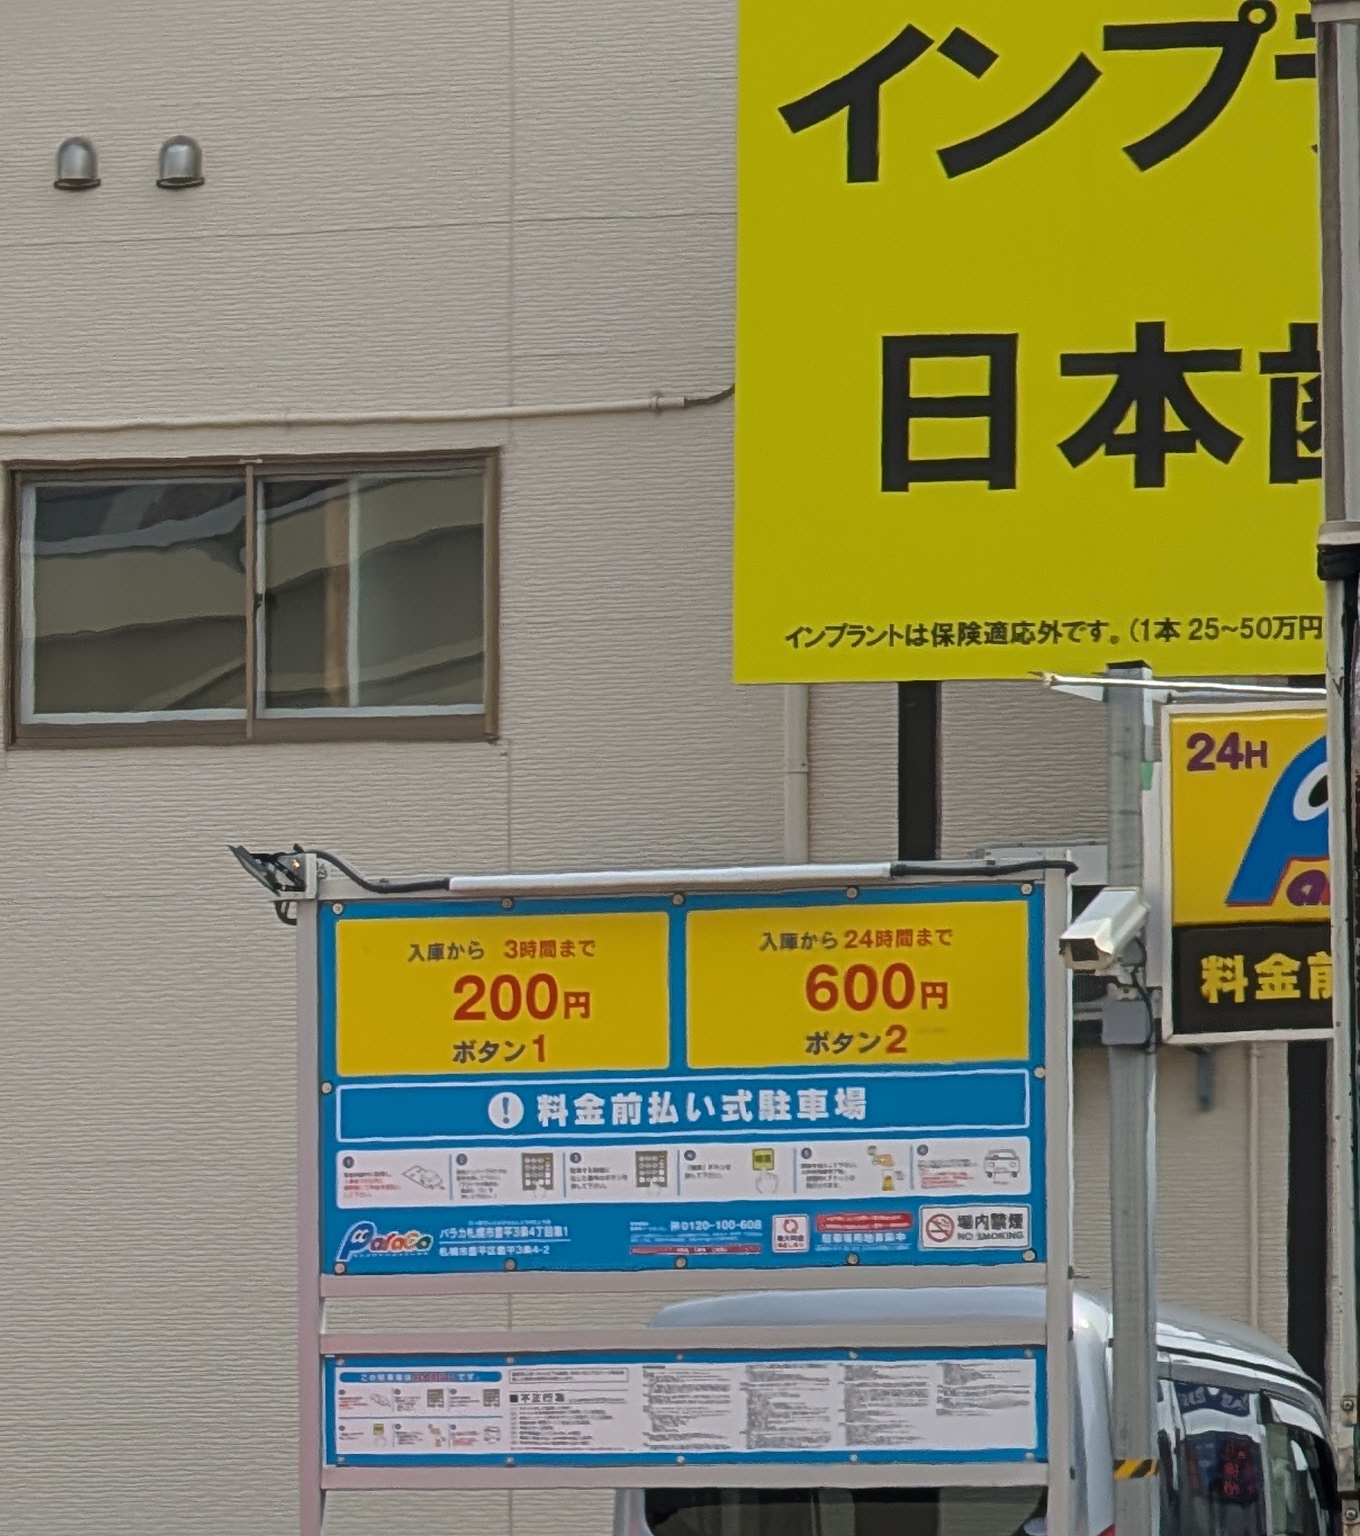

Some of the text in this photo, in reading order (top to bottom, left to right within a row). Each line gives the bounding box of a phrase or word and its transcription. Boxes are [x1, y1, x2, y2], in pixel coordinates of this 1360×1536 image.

[778, 0, 1318, 184] インプ
[1186, 732, 1268, 772] 24H
[453, 973, 592, 1021] 200円
[805, 962, 949, 1012] 600円
[536, 1086, 868, 1128] 料金前払い式駐車場
